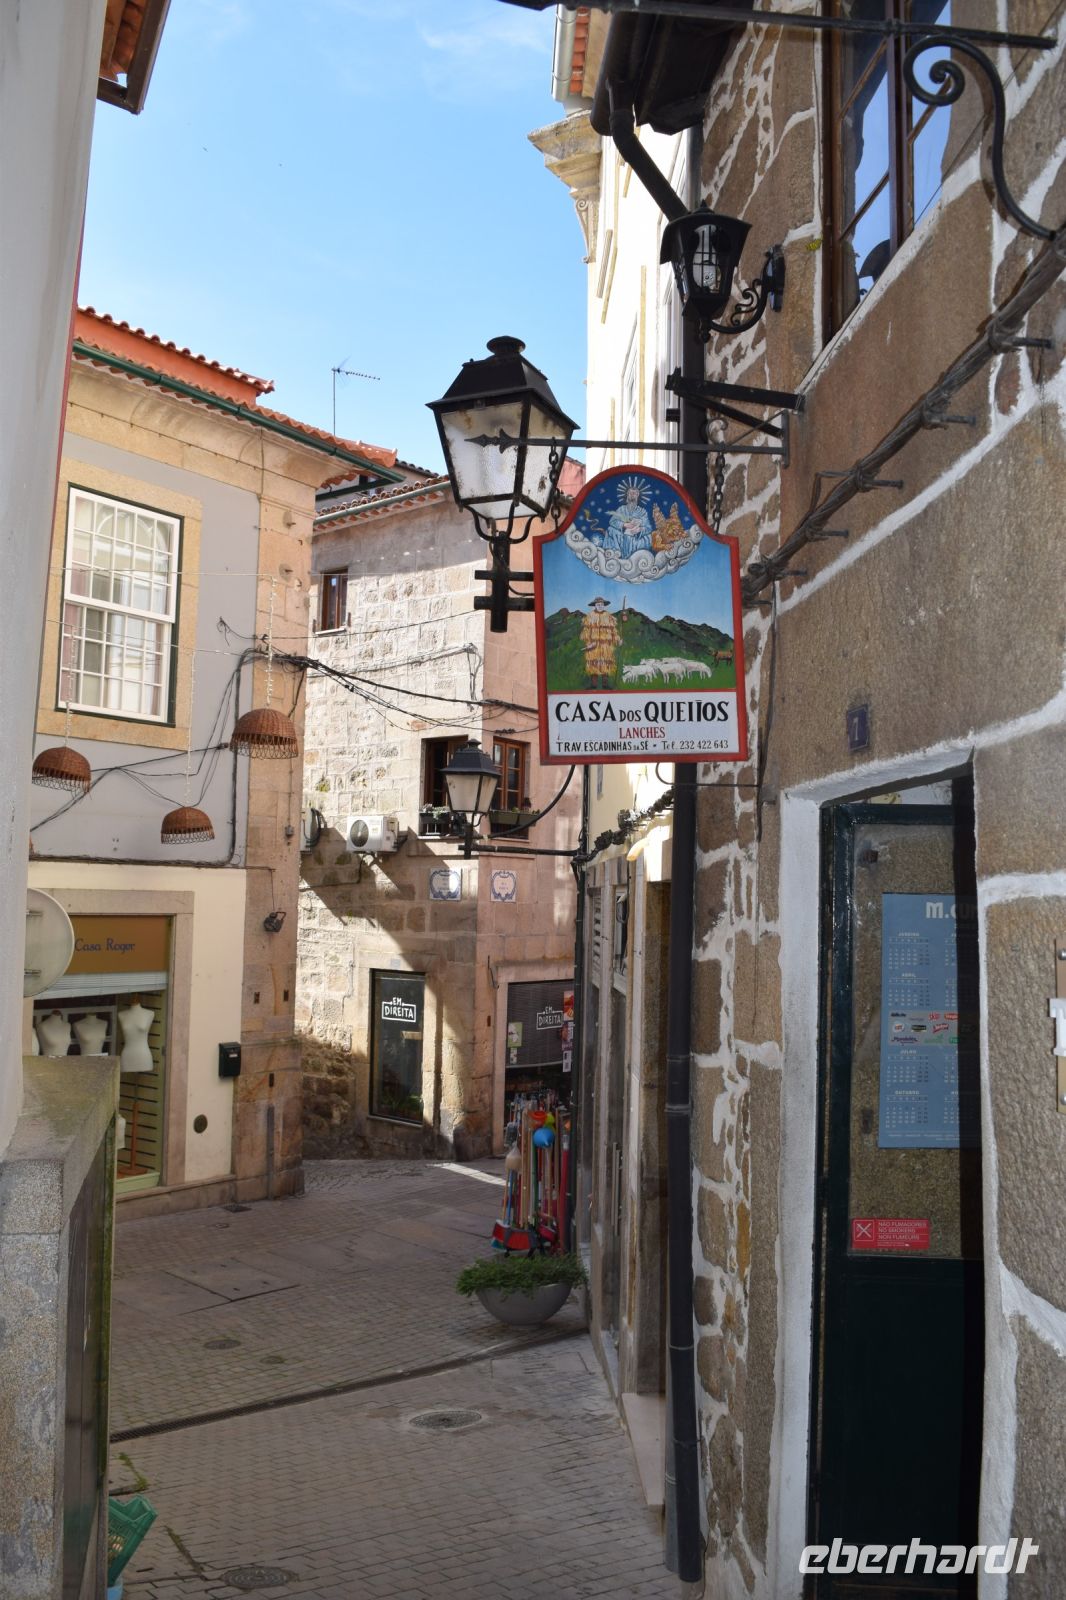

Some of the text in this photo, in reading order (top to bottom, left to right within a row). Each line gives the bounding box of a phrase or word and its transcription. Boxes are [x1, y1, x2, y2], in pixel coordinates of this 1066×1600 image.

[555, 699, 617, 722] CASA
[619, 709, 642, 722] DOS
[619, 726, 666, 739] LANCHES
[584, 741, 632, 752] ESCADINHAS
[679, 740, 695, 750] 232
[697, 739, 712, 750] 422
[714, 739, 729, 750] 643
[75, 937, 136, 954] Casa Roger
[392, 997, 403, 1006] EM
[385, 1006, 414, 1019] DIREITA
[545, 1006, 553, 1014] EM
[538, 1015, 561, 1027] DIREITA
